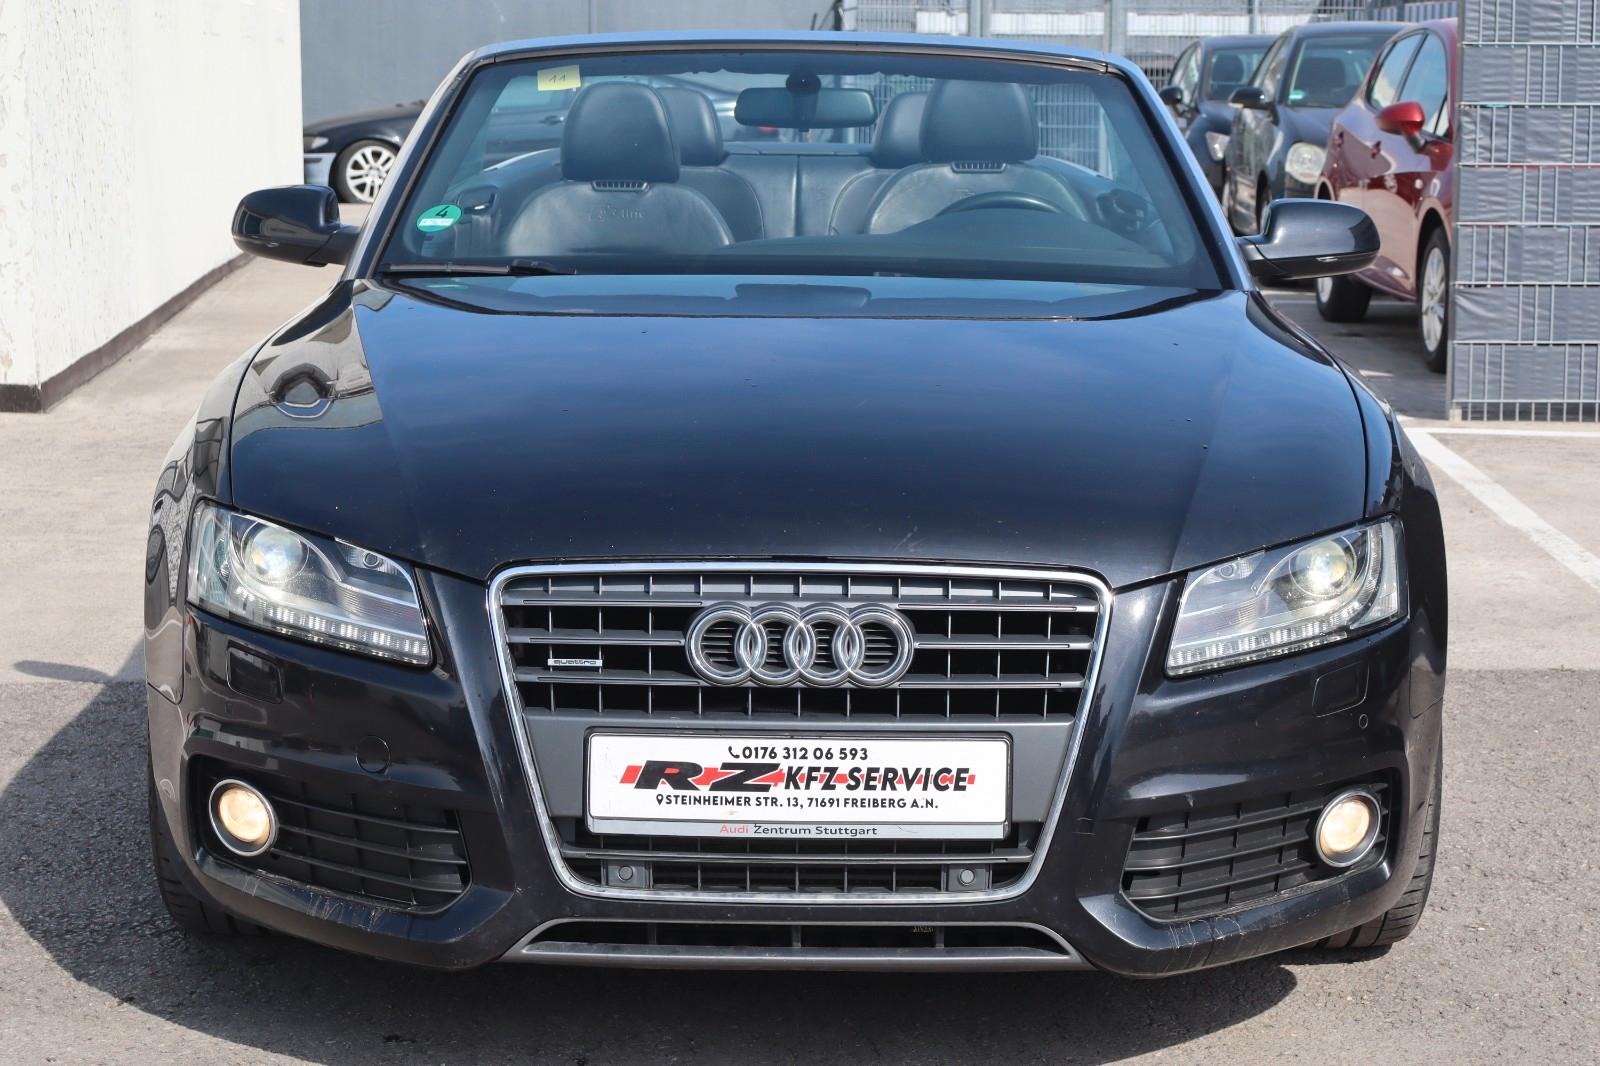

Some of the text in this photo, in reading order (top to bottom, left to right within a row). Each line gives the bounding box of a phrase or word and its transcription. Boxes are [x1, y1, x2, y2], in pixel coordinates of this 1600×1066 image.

[435, 205, 450, 218] 4
[742, 746, 868, 760] 0176 312 06 593
[784, 766, 839, 790] KFZ
[846, 767, 970, 791] SERVICE
[665, 795, 939, 810] STEINHEIMER STR. 13, 71691 FREIBERG A.N.
[720, 825, 878, 837] Audi Zentrum Stuttgart
